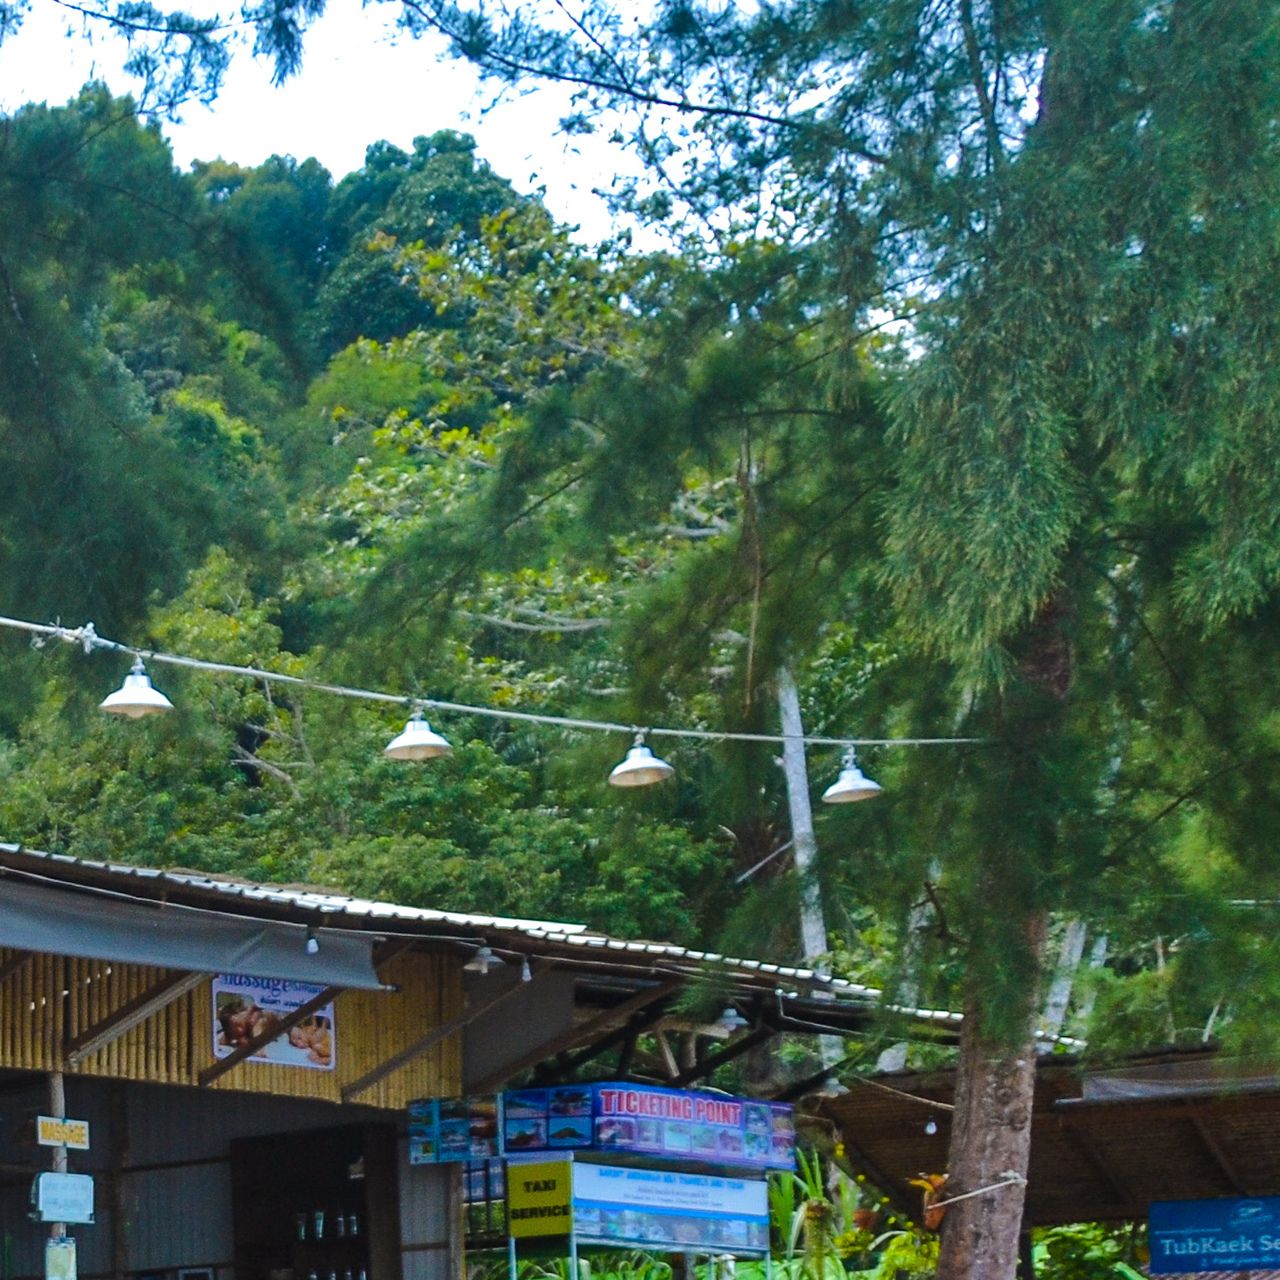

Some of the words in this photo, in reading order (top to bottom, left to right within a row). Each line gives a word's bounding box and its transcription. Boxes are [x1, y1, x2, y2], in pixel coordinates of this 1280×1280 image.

[600, 1088, 692, 1120] TICKETING
[696, 1099, 740, 1126] POINT
[523, 1179, 556, 1193] TAXI
[511, 1204, 570, 1220] SERVICE
[1160, 1235, 1254, 1255] TubKaek
